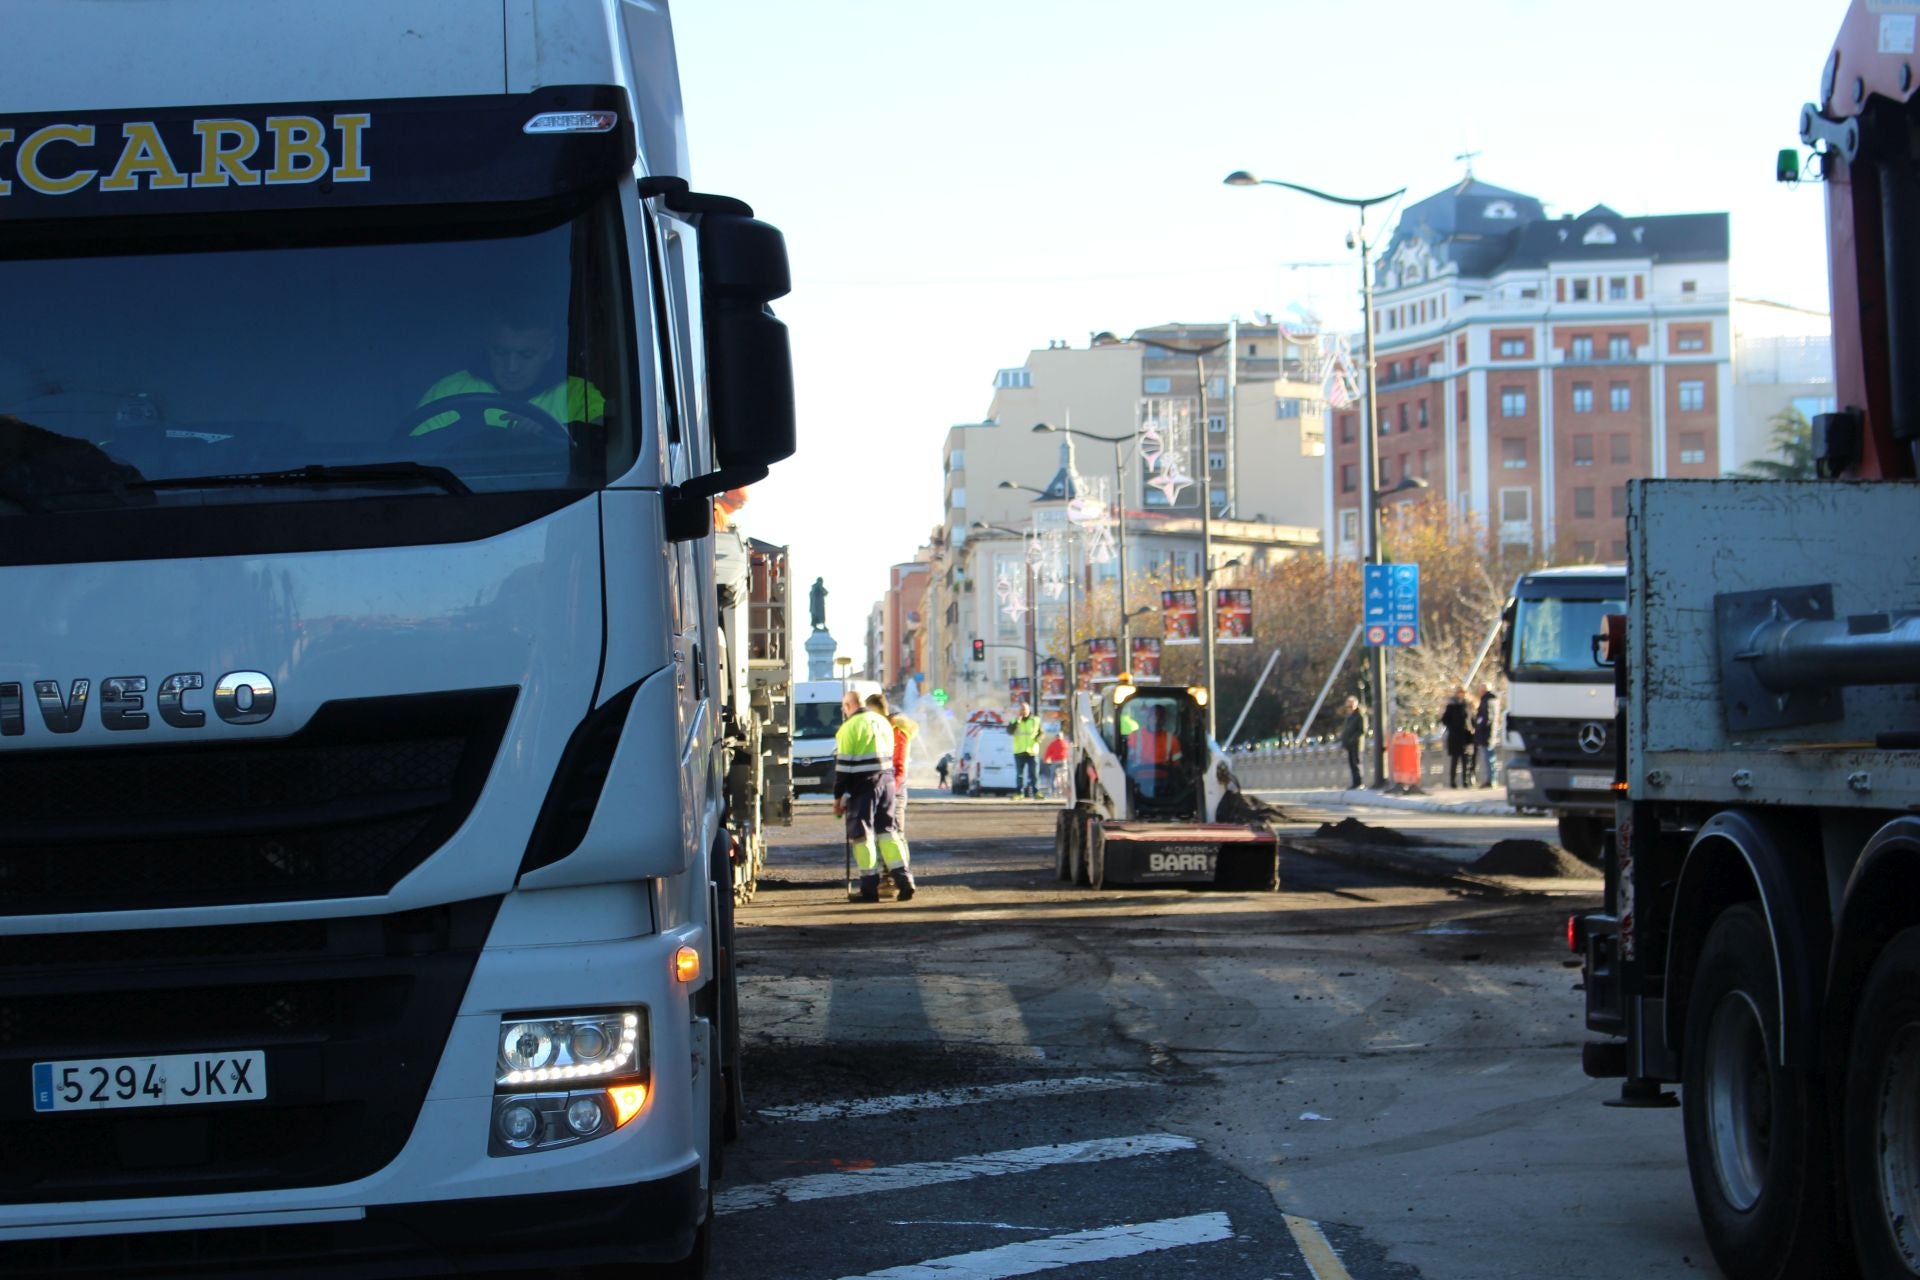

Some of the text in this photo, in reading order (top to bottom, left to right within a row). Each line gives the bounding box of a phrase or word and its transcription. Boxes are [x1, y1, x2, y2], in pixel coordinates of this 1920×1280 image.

[0, 113, 370, 195] CARBI
[0, 670, 277, 736] IVECO
[62, 1058, 253, 1103] 5294 JKX
